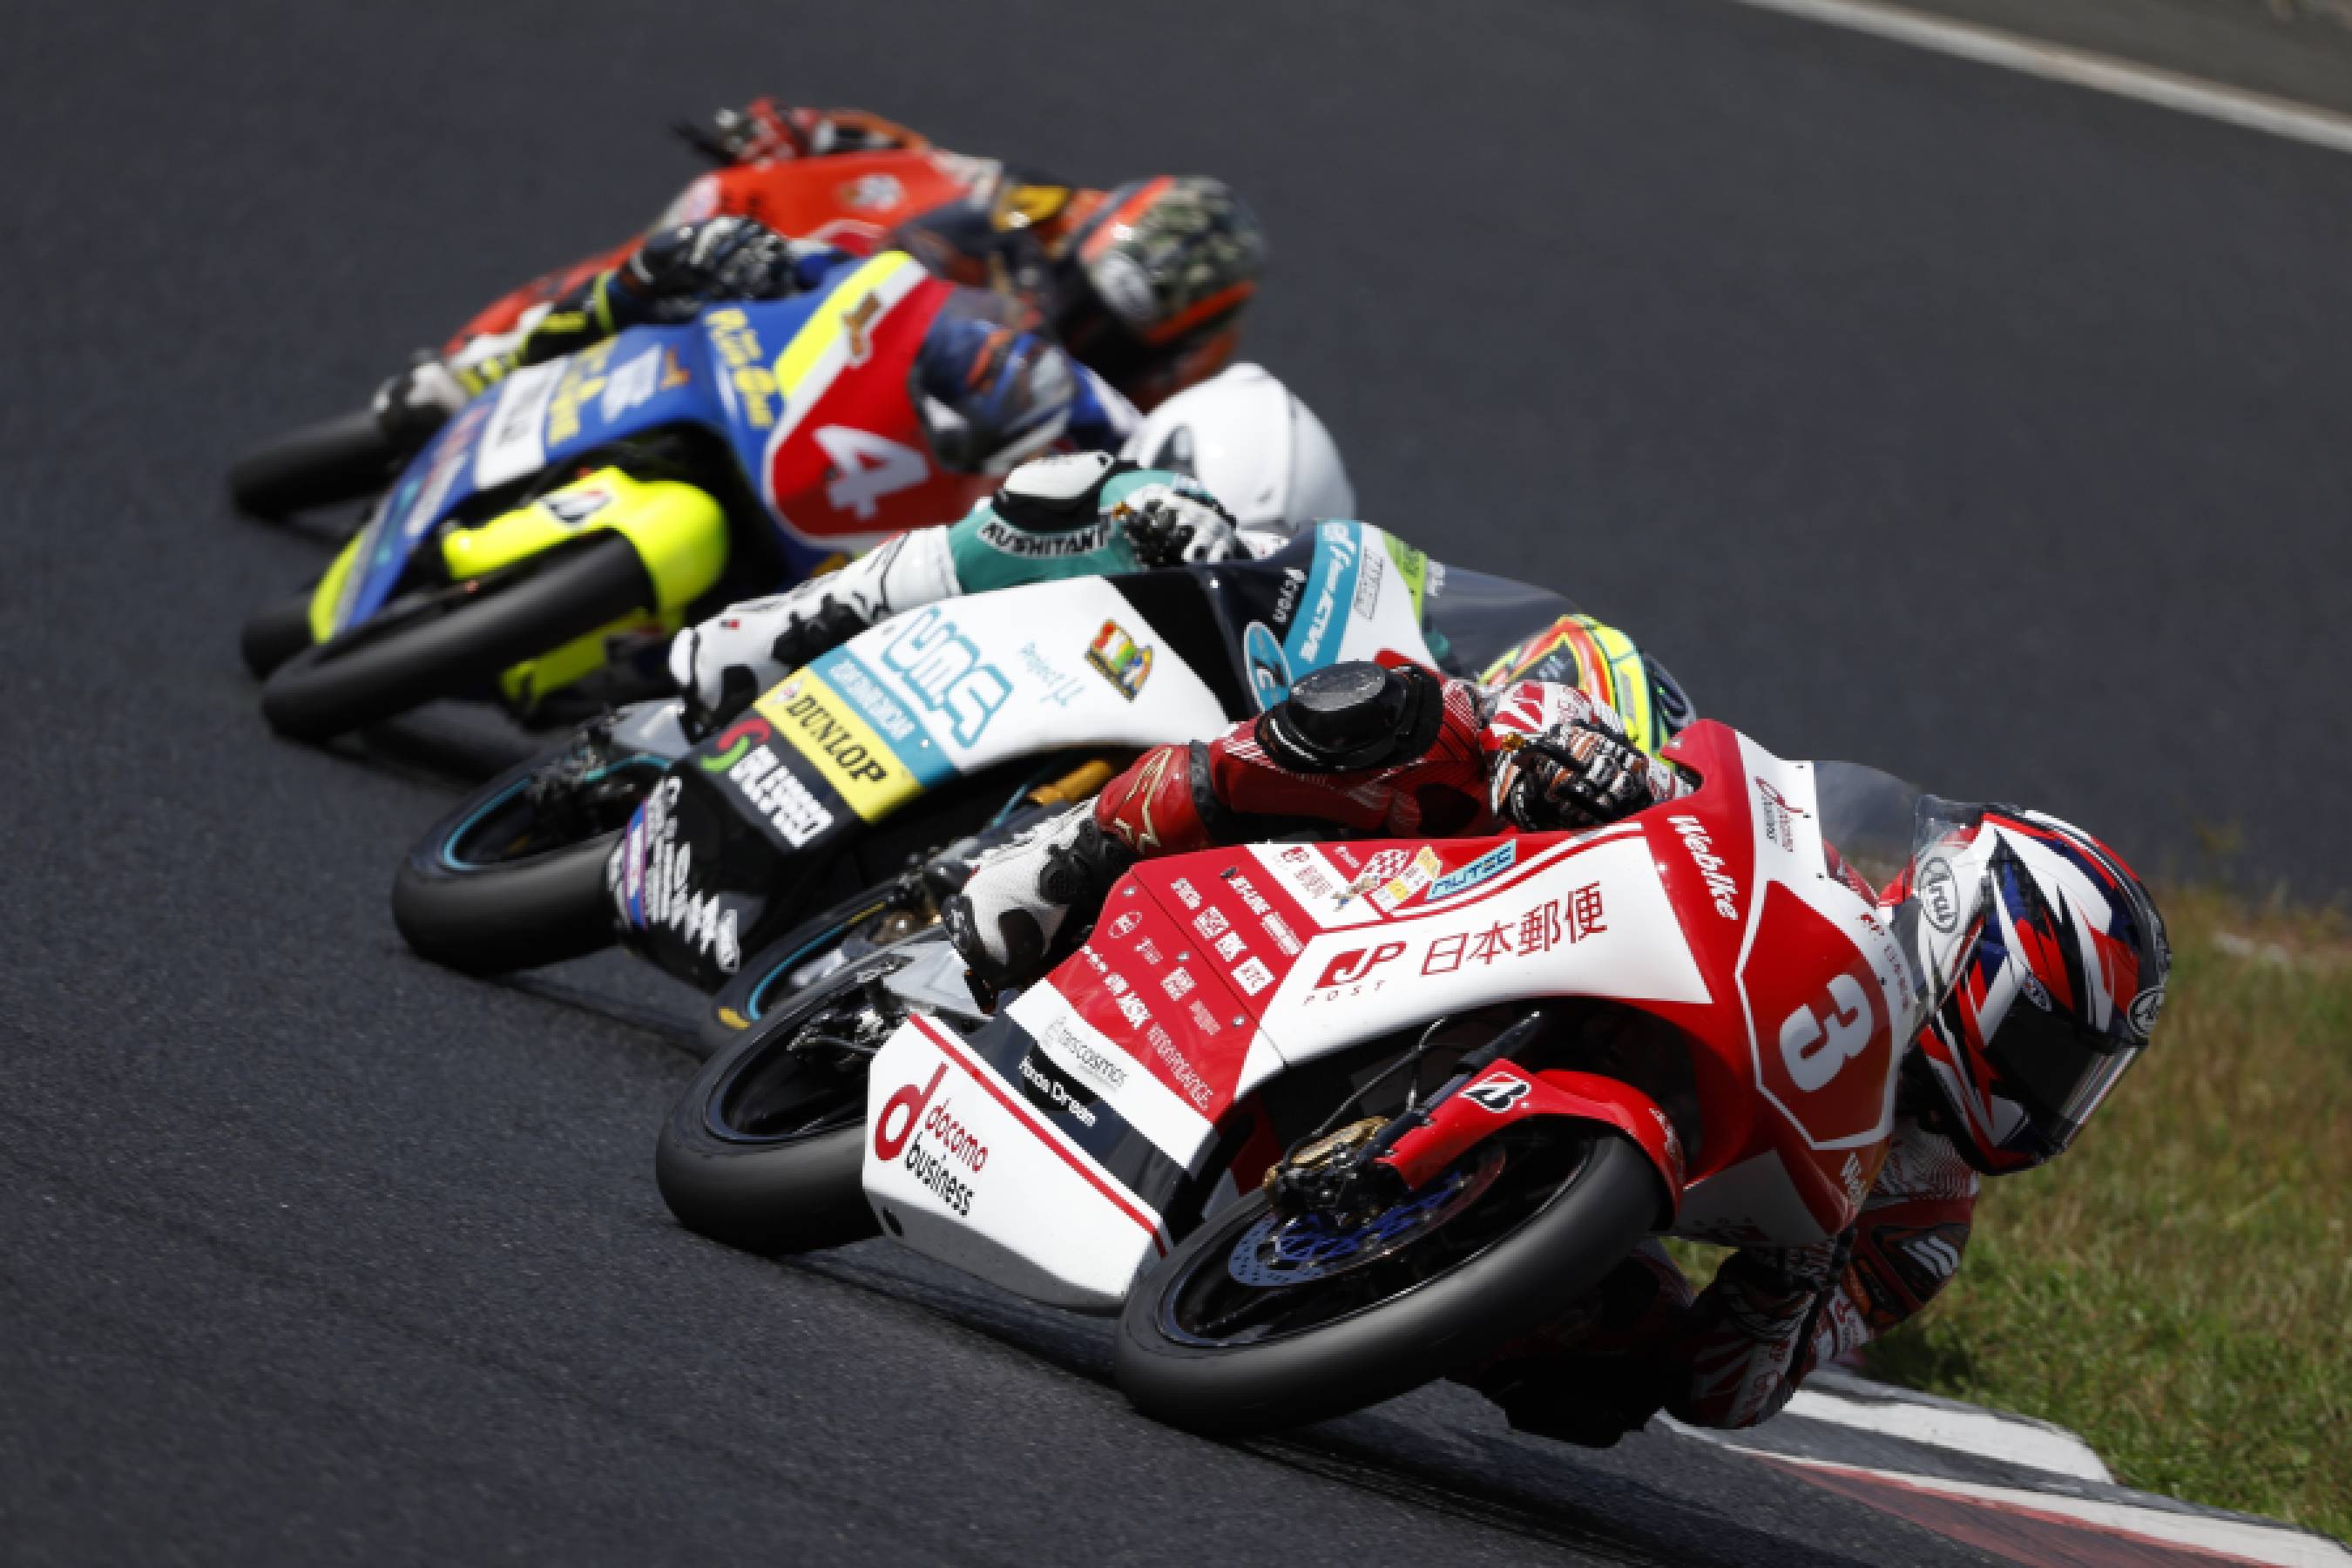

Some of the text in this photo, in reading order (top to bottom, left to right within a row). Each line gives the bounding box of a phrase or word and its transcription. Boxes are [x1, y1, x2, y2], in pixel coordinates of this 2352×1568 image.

[813, 425, 928, 519] 4
[787, 694, 888, 782] DUNLOP
[1666, 815, 1739, 920] Webike
[1314, 941, 1407, 990] JP
[1420, 881, 1609, 977] 日本郵便
[1303, 979, 1386, 1005] POST
[1779, 974, 1873, 1093] 3
[924, 1097, 989, 1173] docomo
[1051, 1081, 1097, 1127] Dream
[904, 1132, 975, 1217] business
